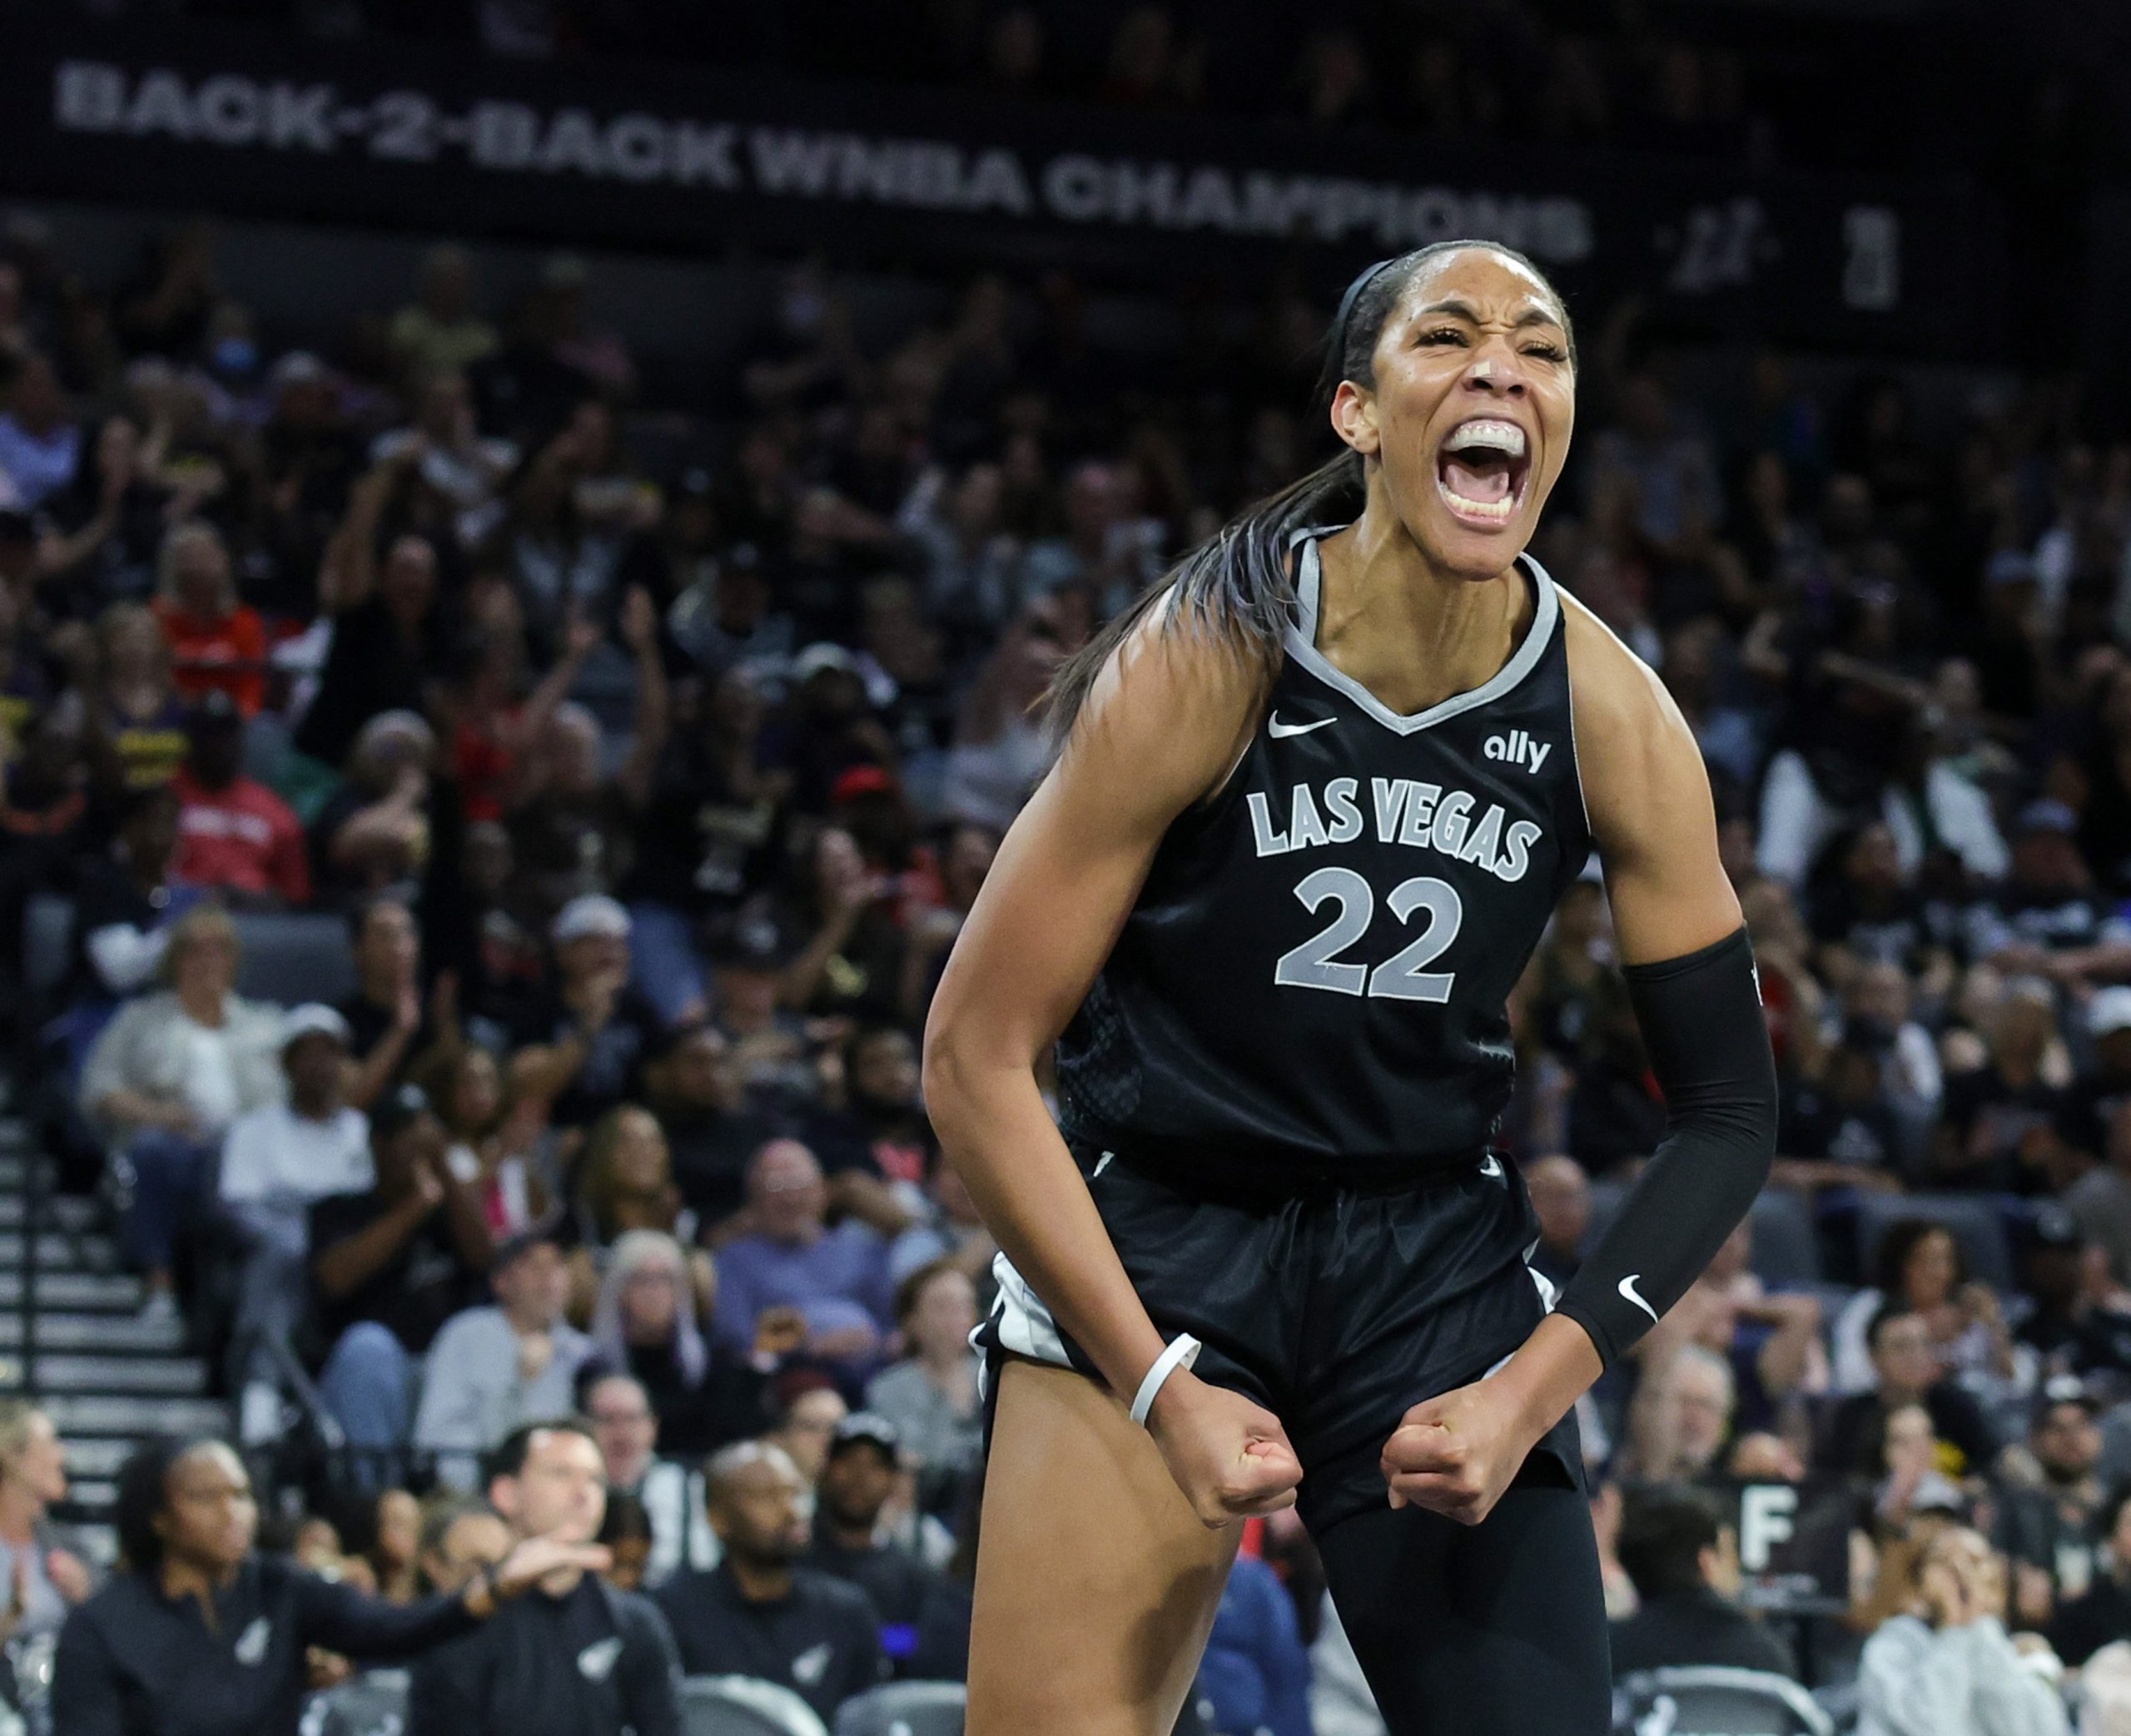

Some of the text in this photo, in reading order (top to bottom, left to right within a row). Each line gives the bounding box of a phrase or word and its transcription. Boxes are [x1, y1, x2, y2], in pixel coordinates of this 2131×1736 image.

[54, 59, 1593, 263] BACK-2-BACK WNBA CHAMPIONS
[1483, 730, 1551, 774] ally
[1246, 777, 1542, 882] LAS VEGAS
[1274, 866, 1463, 1003] 22
[1741, 1485, 1798, 1571] F
